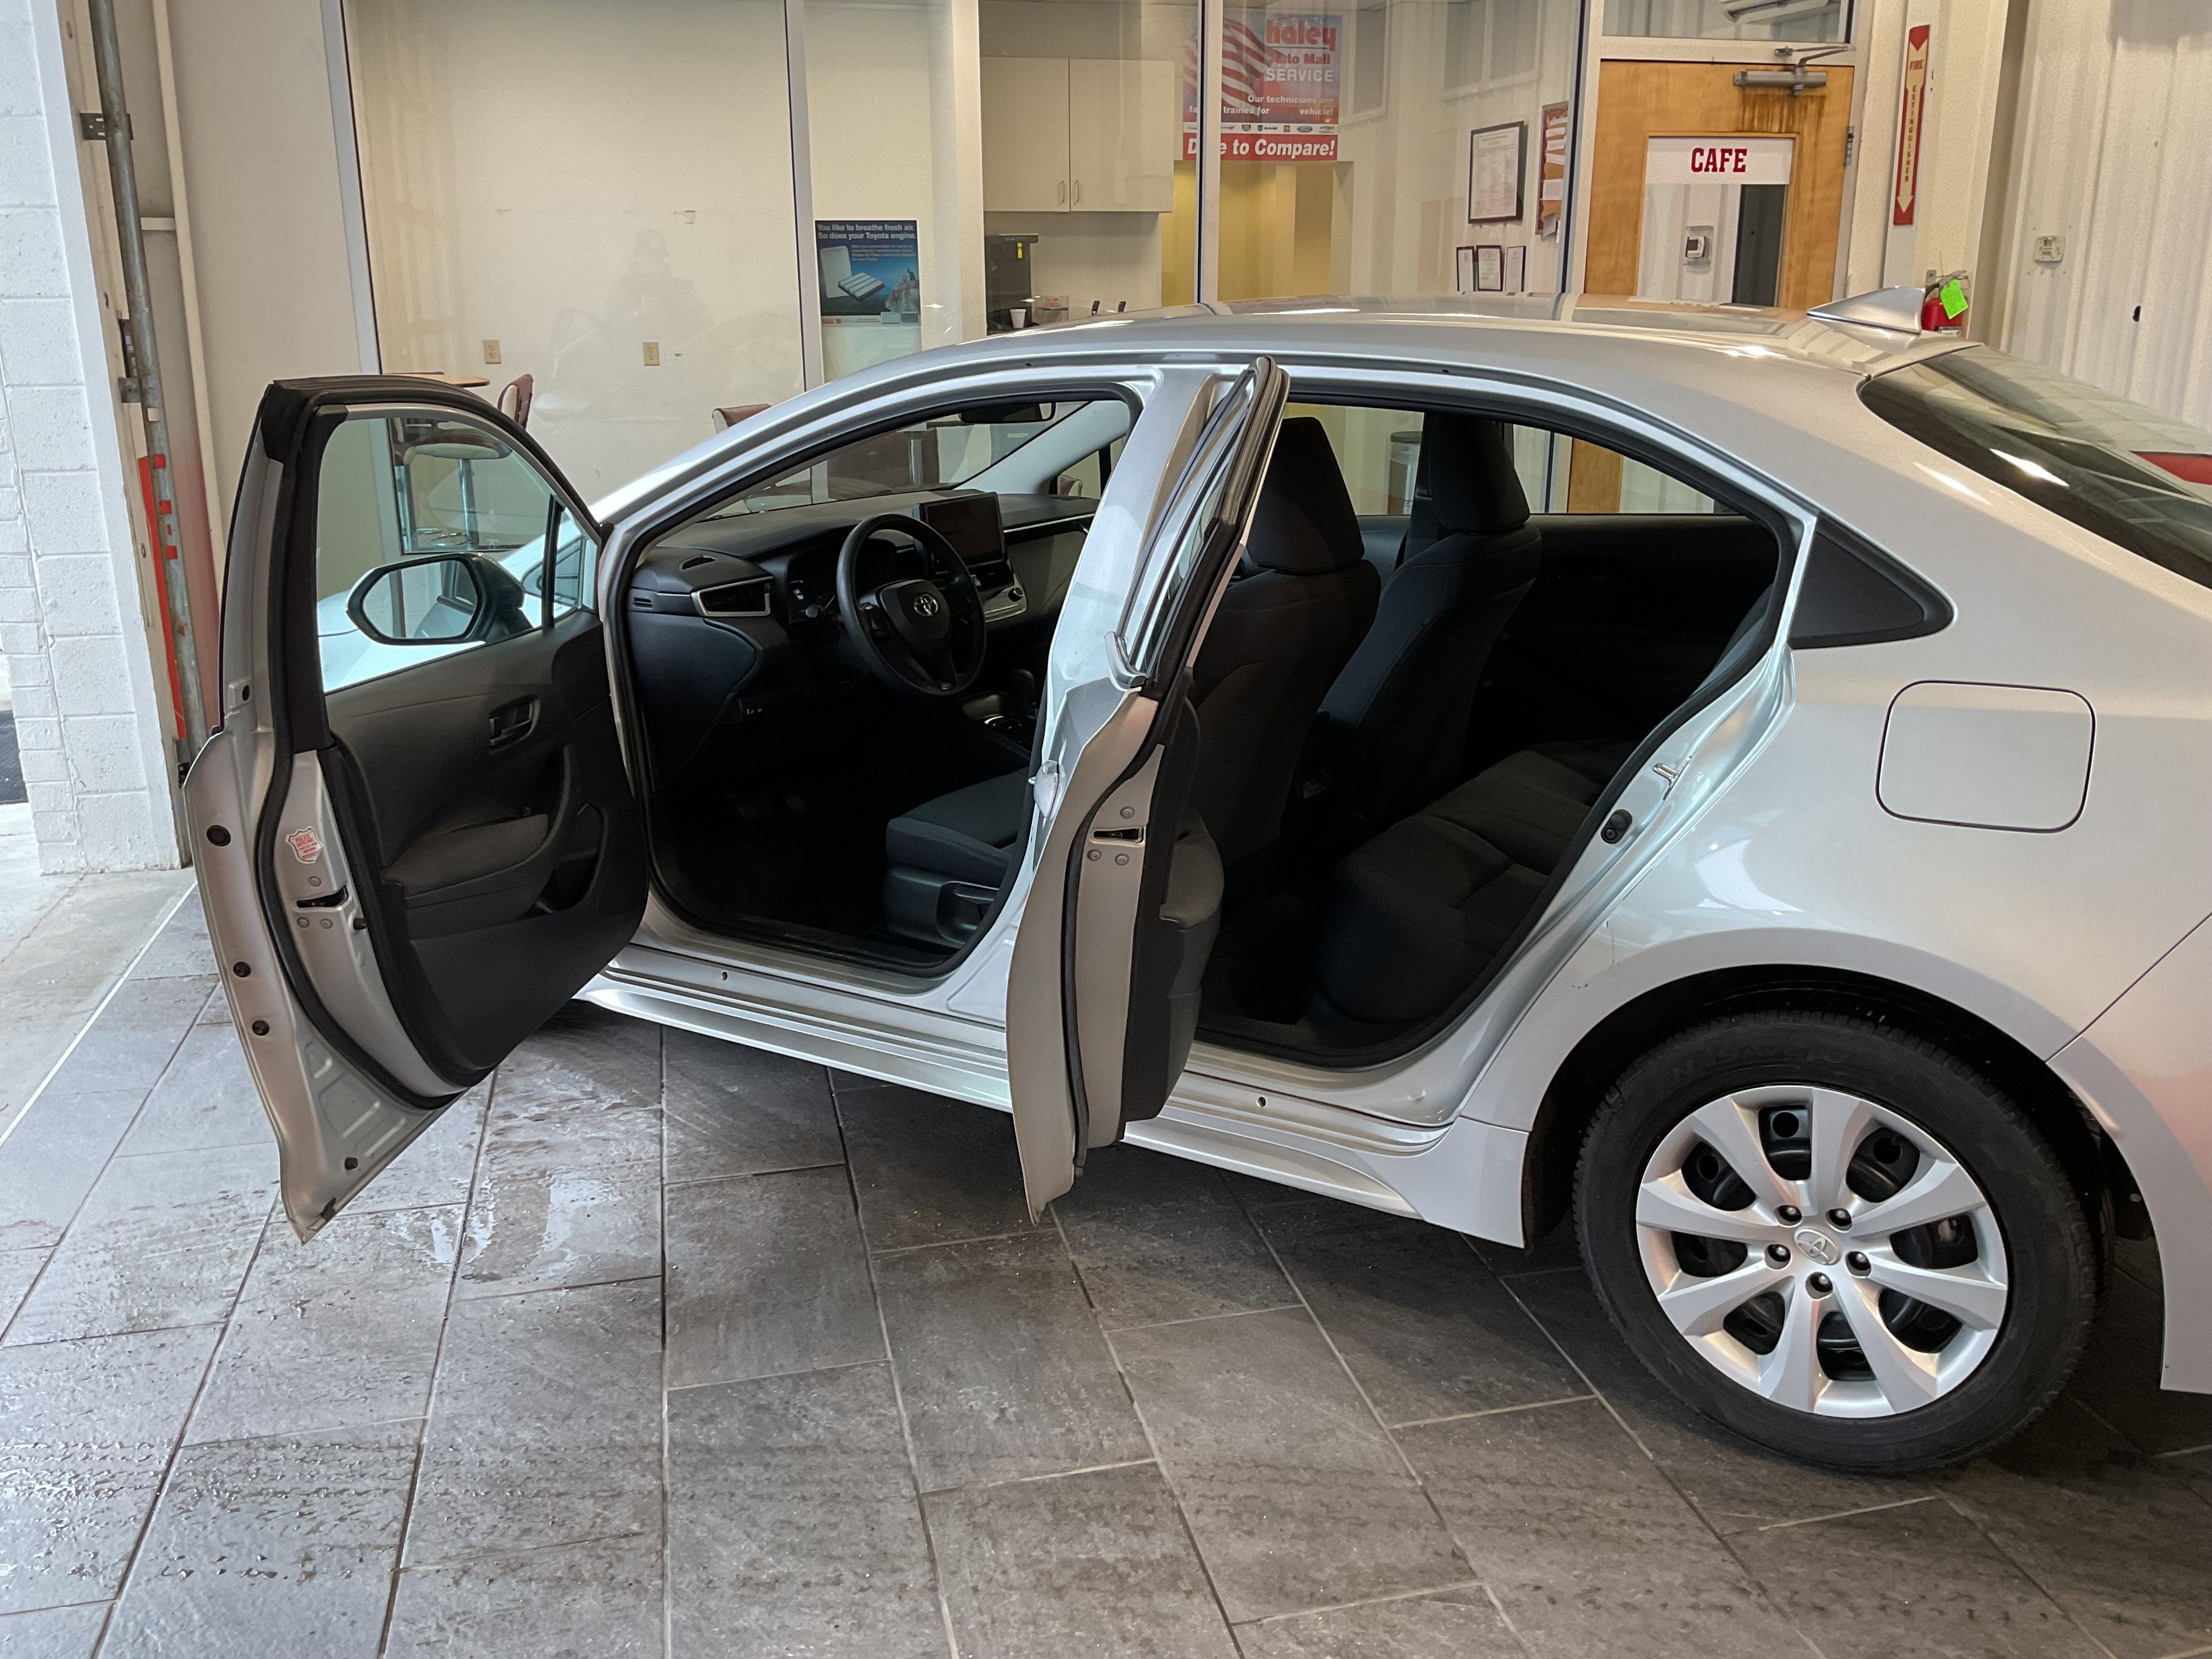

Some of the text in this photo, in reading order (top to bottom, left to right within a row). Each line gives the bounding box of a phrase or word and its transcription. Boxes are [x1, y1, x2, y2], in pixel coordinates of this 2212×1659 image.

[1266, 19, 1336, 52] haley
[1271, 53, 1330, 65] Auto Mall
[1910, 59, 1923, 70] FIRE
[1266, 67, 1334, 82] SERVICE
[1248, 94, 1265, 103] Our
[1267, 95, 1316, 104] technicians
[1223, 106, 1334, 116] trained for vehicle!
[1904, 85, 1917, 182] EXTINGUISHER
[1232, 139, 1250, 155] to
[1254, 138, 1336, 159] Compare!
[1691, 147, 1748, 173] CAFE
[890, 233, 917, 241] engine.
